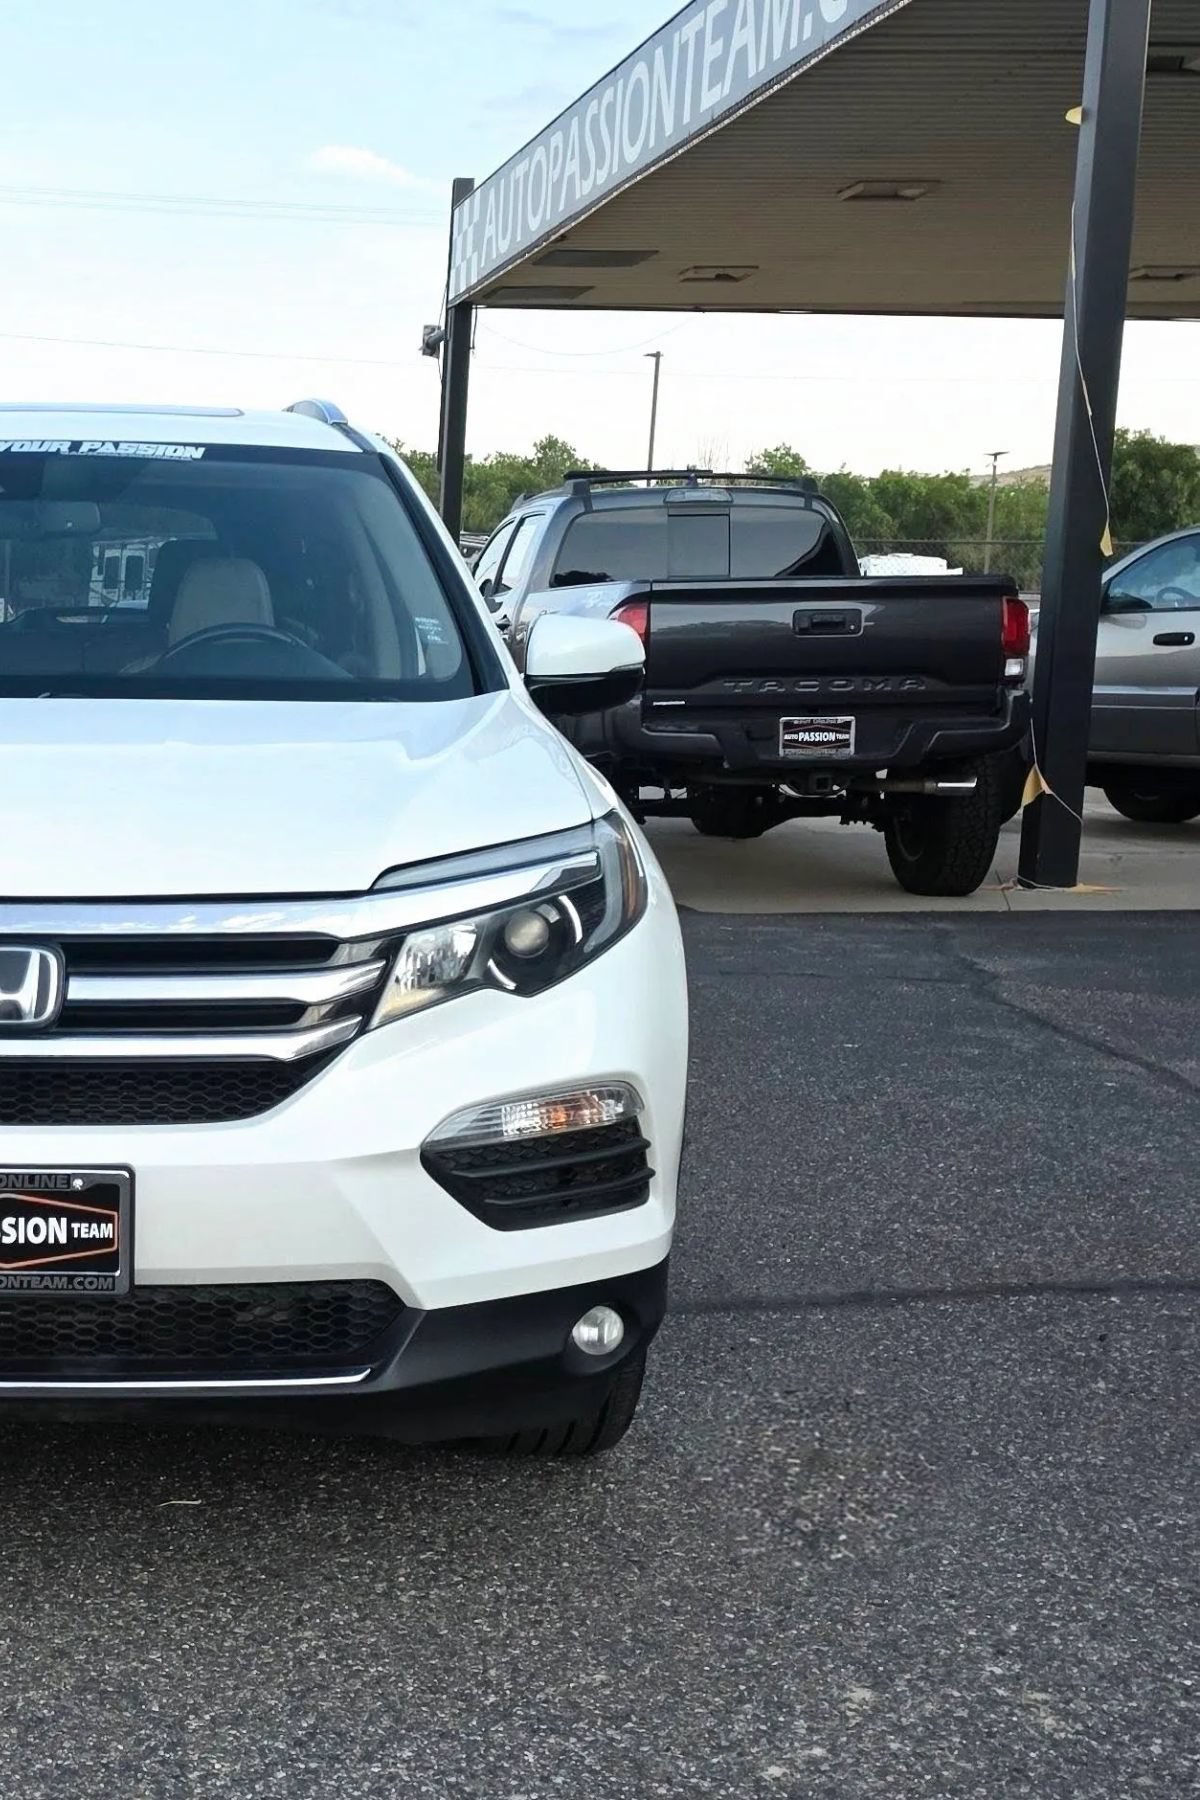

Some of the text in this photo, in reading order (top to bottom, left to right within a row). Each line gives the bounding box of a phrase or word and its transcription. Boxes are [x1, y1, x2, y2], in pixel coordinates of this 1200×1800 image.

[78, 441, 205, 459] PASSION
[723, 679, 927, 693] TACOMA
[798, 731, 836, 742] PASSION
[71, 1222, 113, 1239] TEAM
